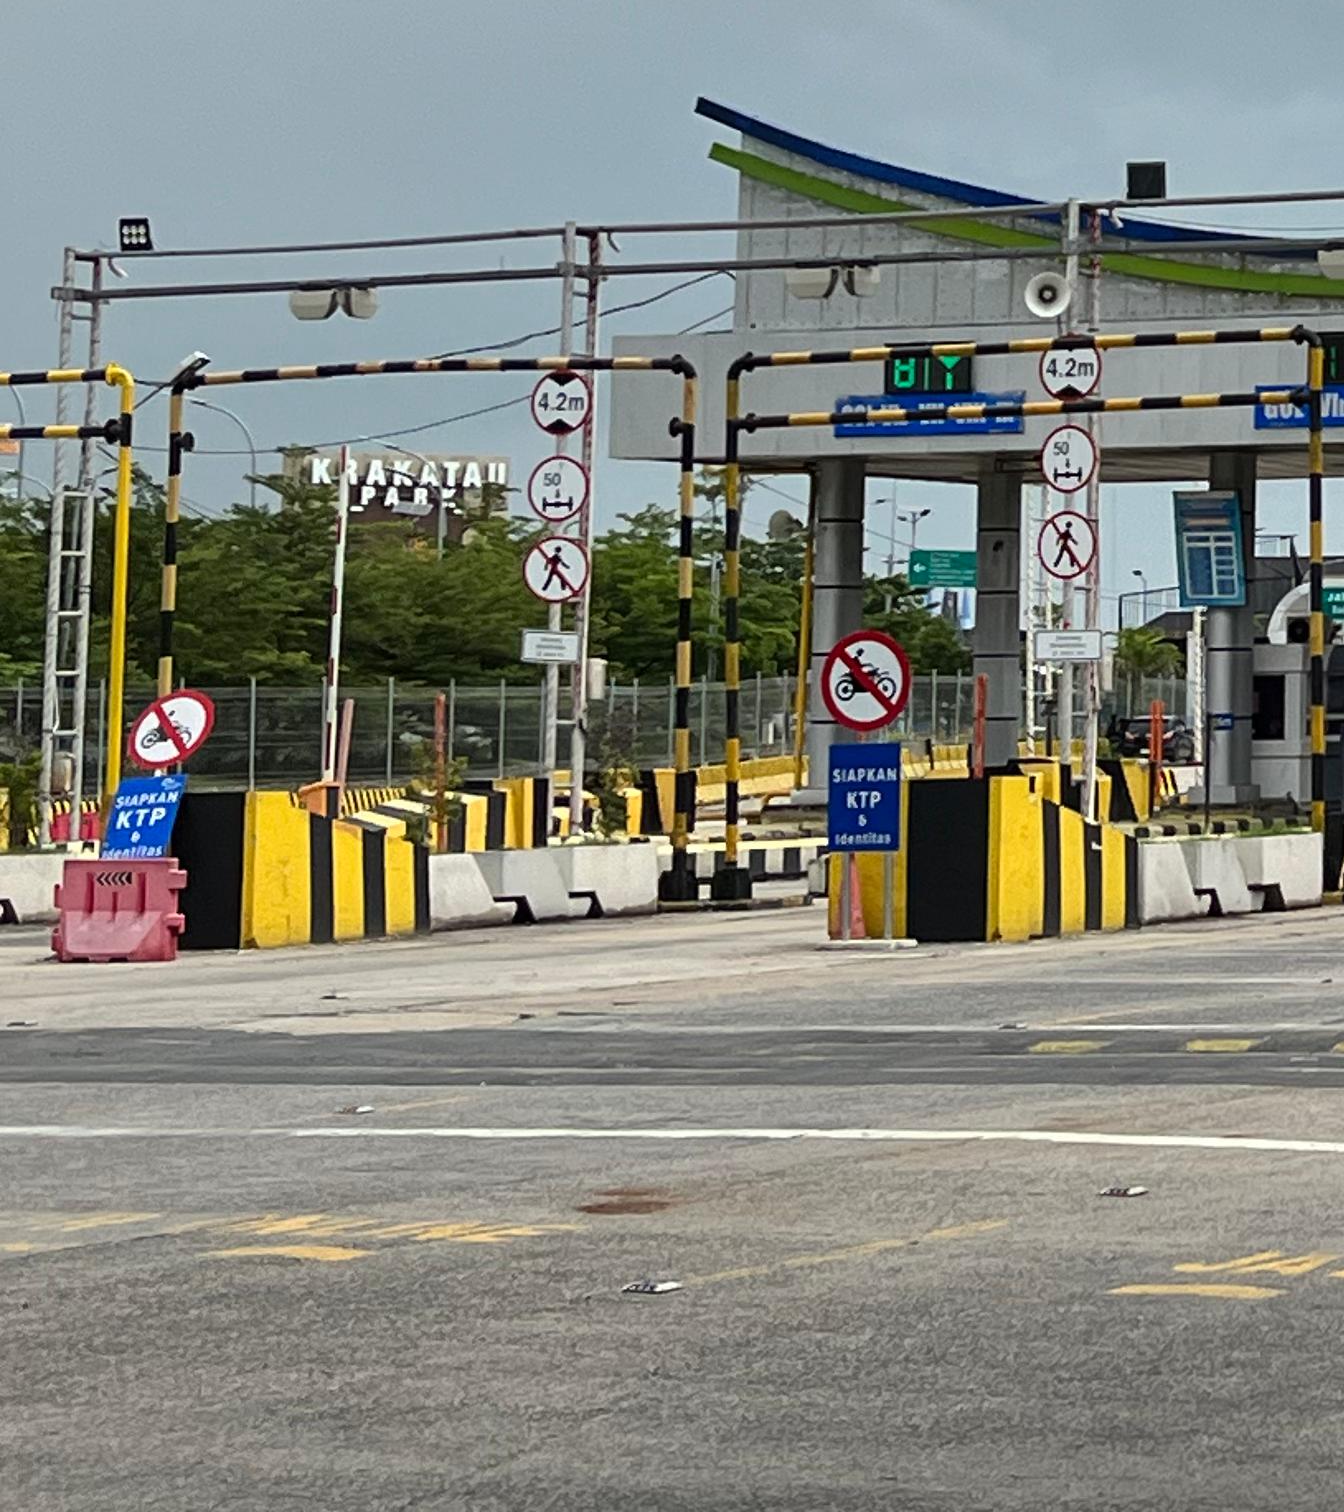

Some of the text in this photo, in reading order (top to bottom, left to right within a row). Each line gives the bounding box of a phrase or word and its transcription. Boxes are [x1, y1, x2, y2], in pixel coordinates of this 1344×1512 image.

[1046, 357, 1094, 378] 4.2m
[538, 392, 585, 412] 4.2m
[1053, 441, 1070, 456] 50
[543, 472, 561, 487] 50
[832, 768, 897, 783] SIAPKAN
[116, 791, 179, 809] SIAPKAN
[847, 791, 881, 808] KTP
[116, 807, 166, 829] KTP
[835, 832, 891, 845] Identitas
